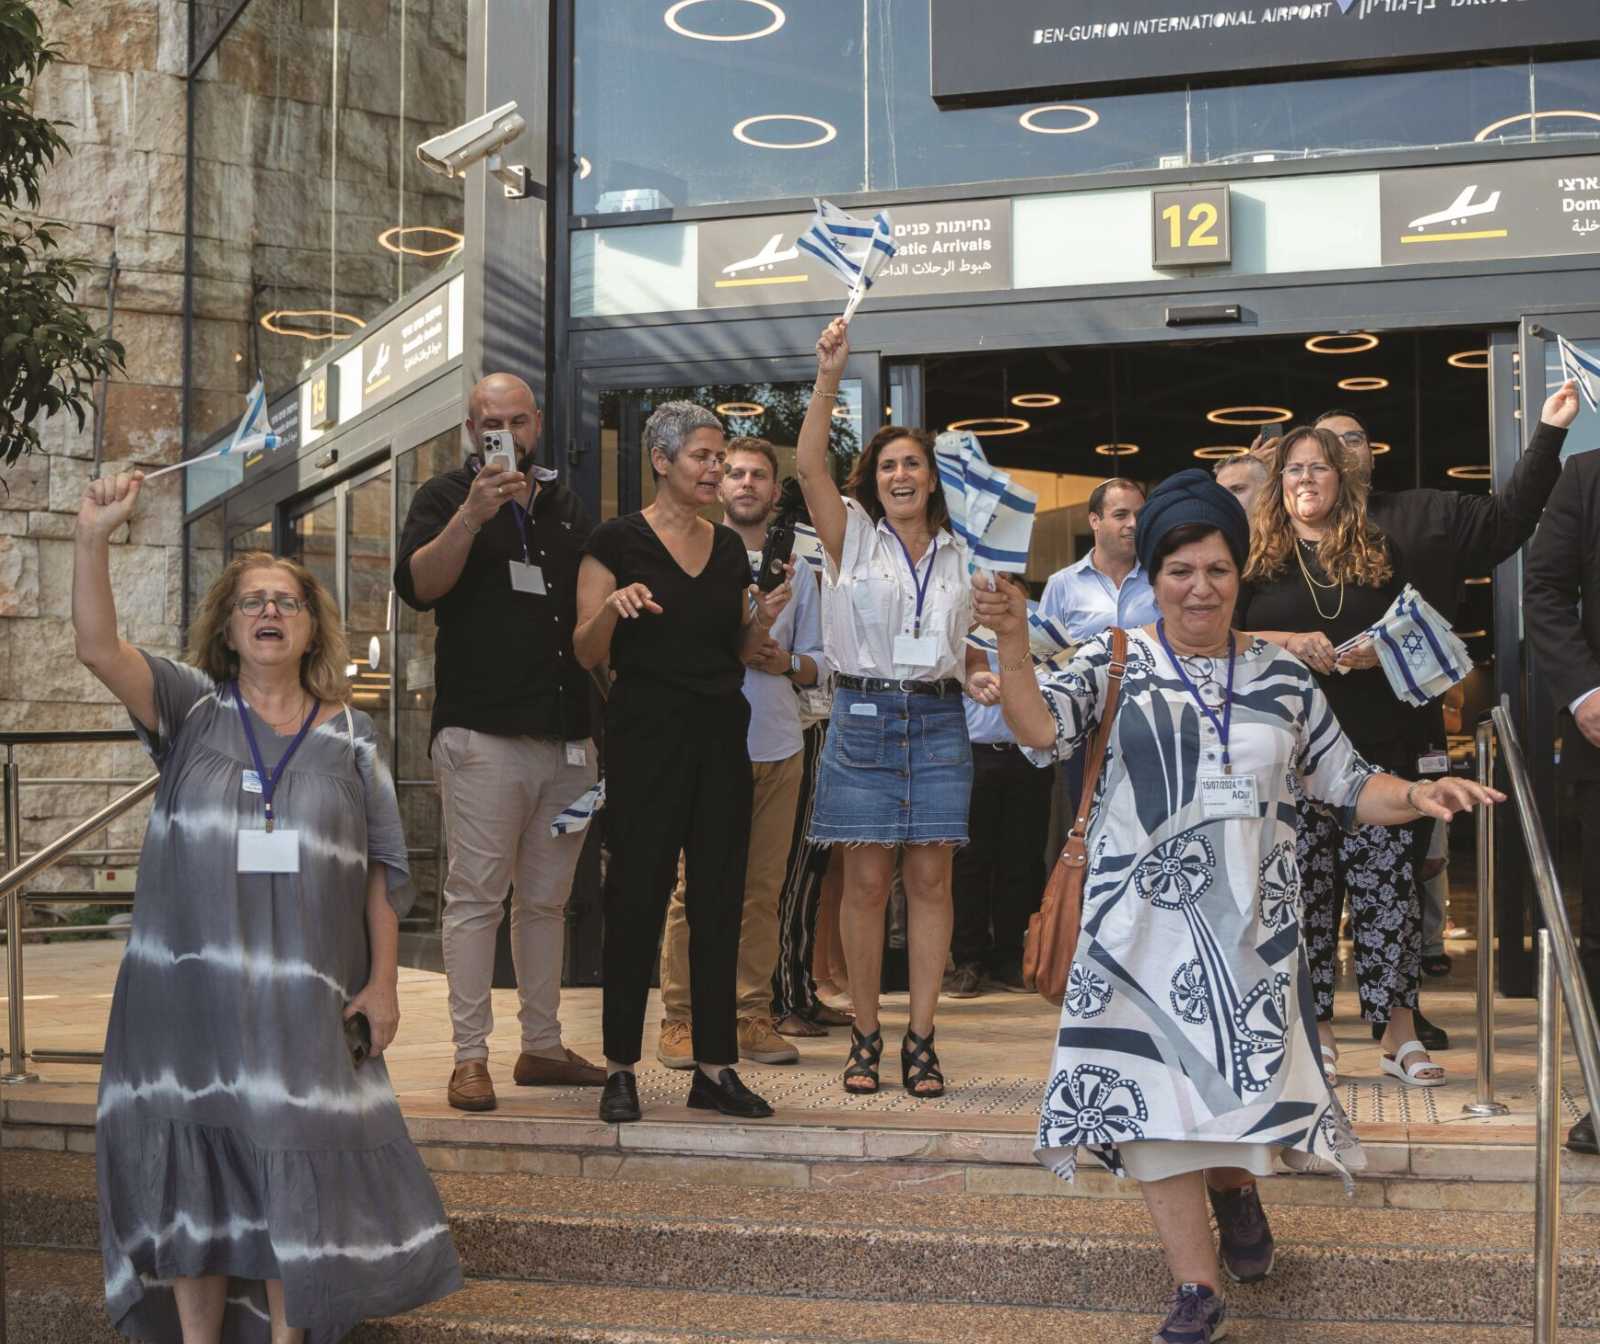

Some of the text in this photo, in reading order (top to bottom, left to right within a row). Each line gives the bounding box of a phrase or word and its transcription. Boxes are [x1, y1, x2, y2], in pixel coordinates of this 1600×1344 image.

[1033, 2, 1333, 44] BEN-GURION INTERNATIONAL AIRPORT
[894, 218, 991, 237] נחיתות פנים
[1162, 202, 1218, 248] 12
[932, 238, 992, 254] Arrivals
[911, 260, 955, 276] الرحلات
[959, 259, 992, 275] هبوط
[312, 378, 325, 415] 13
